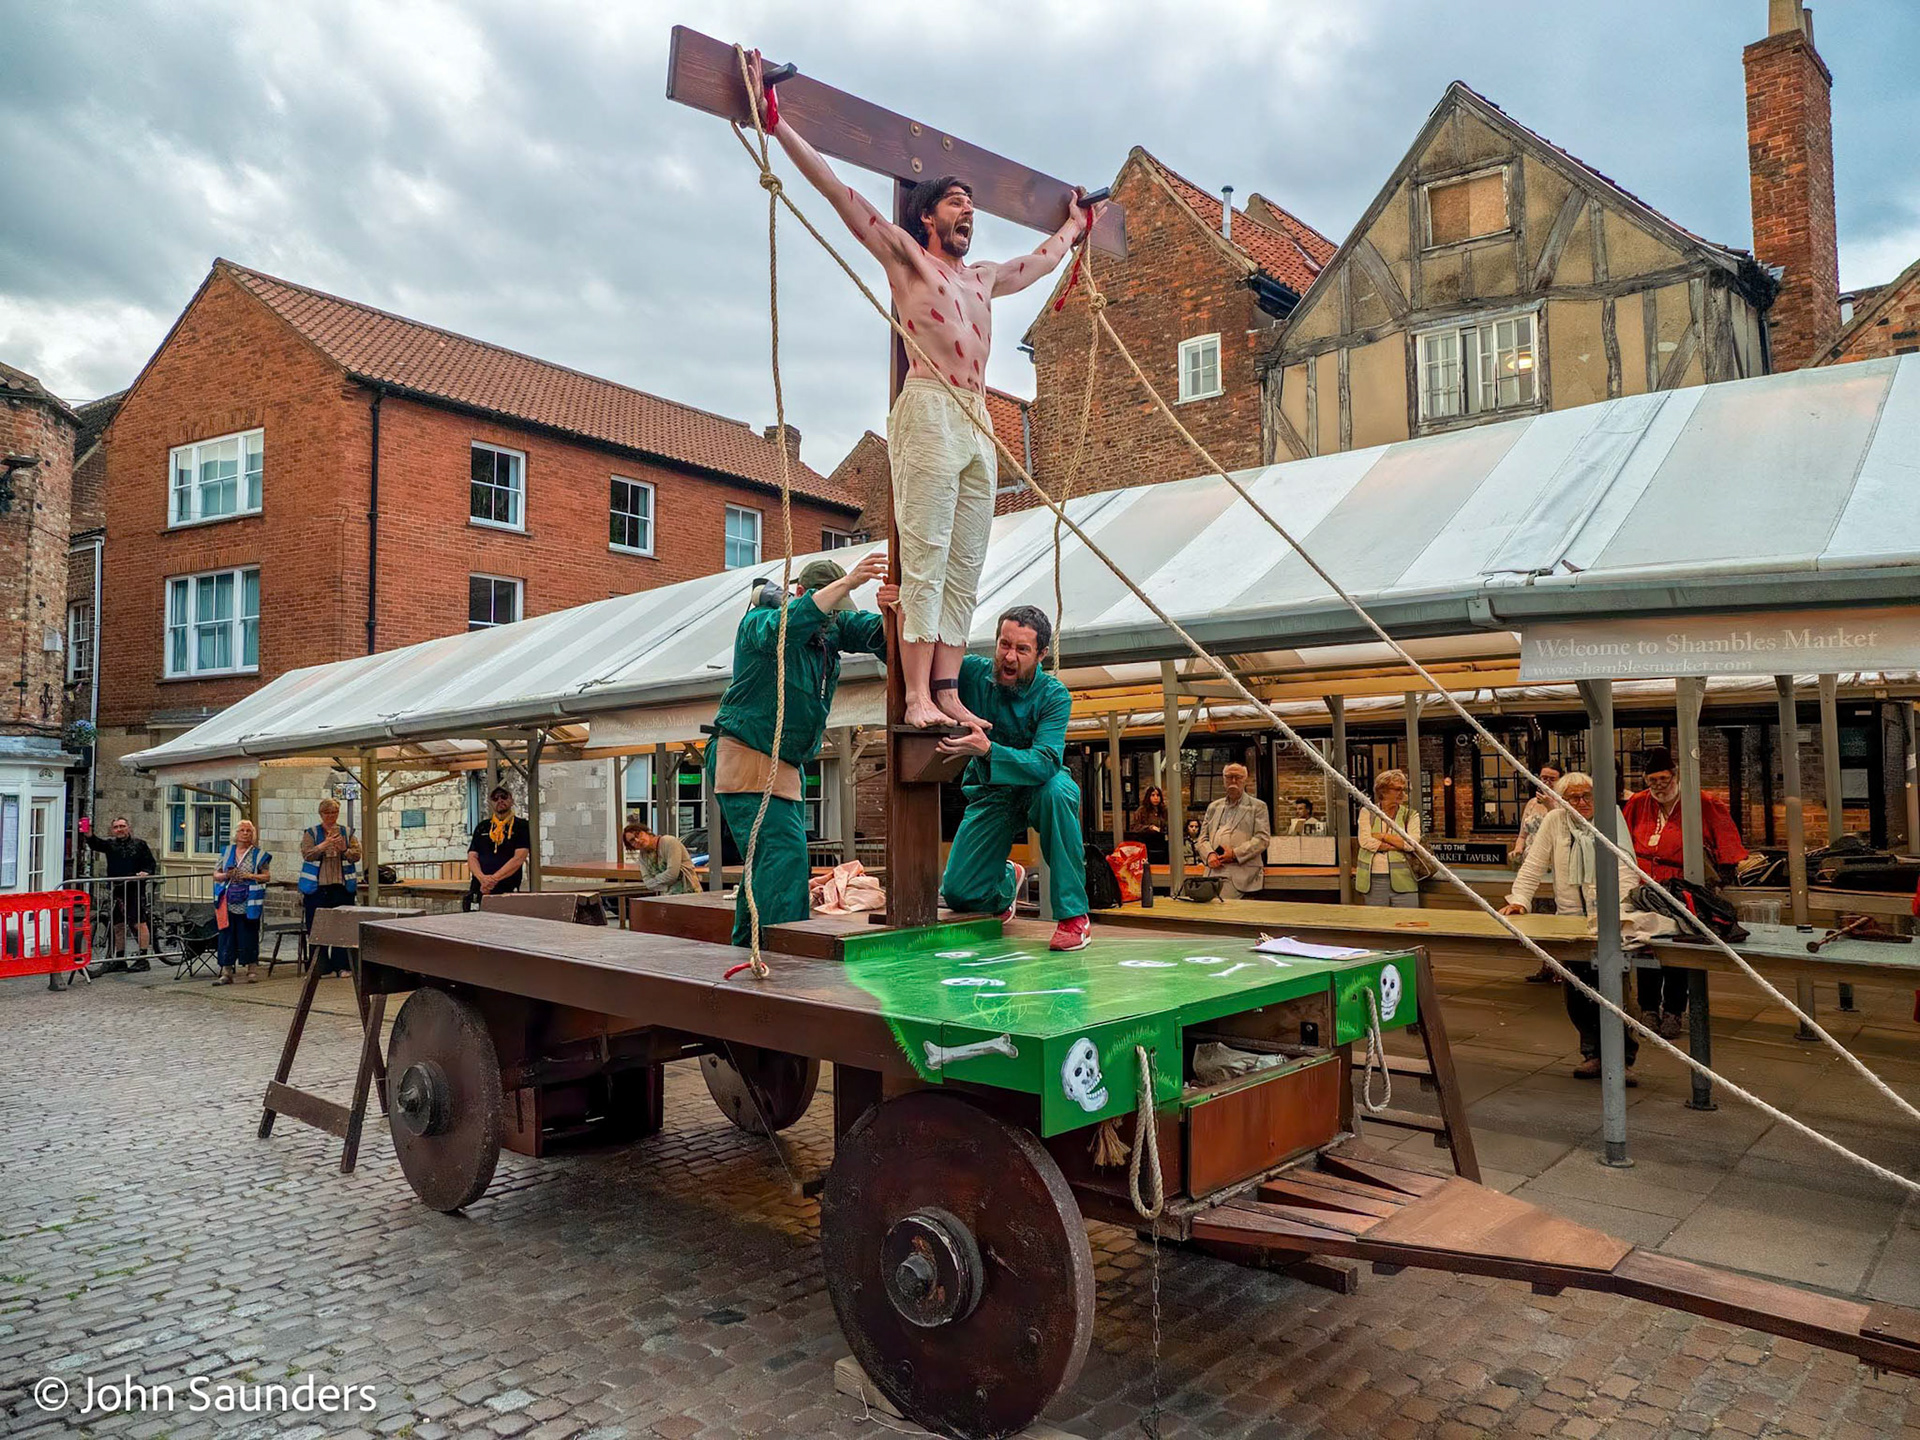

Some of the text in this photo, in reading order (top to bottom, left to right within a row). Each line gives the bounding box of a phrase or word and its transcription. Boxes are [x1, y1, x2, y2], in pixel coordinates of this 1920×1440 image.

[1535, 627, 1878, 658] Welcome to Shambles Market
[1533, 659, 1752, 678] www.shamblesmarket.com
[1435, 853, 1500, 862] ARKET TAVERN
